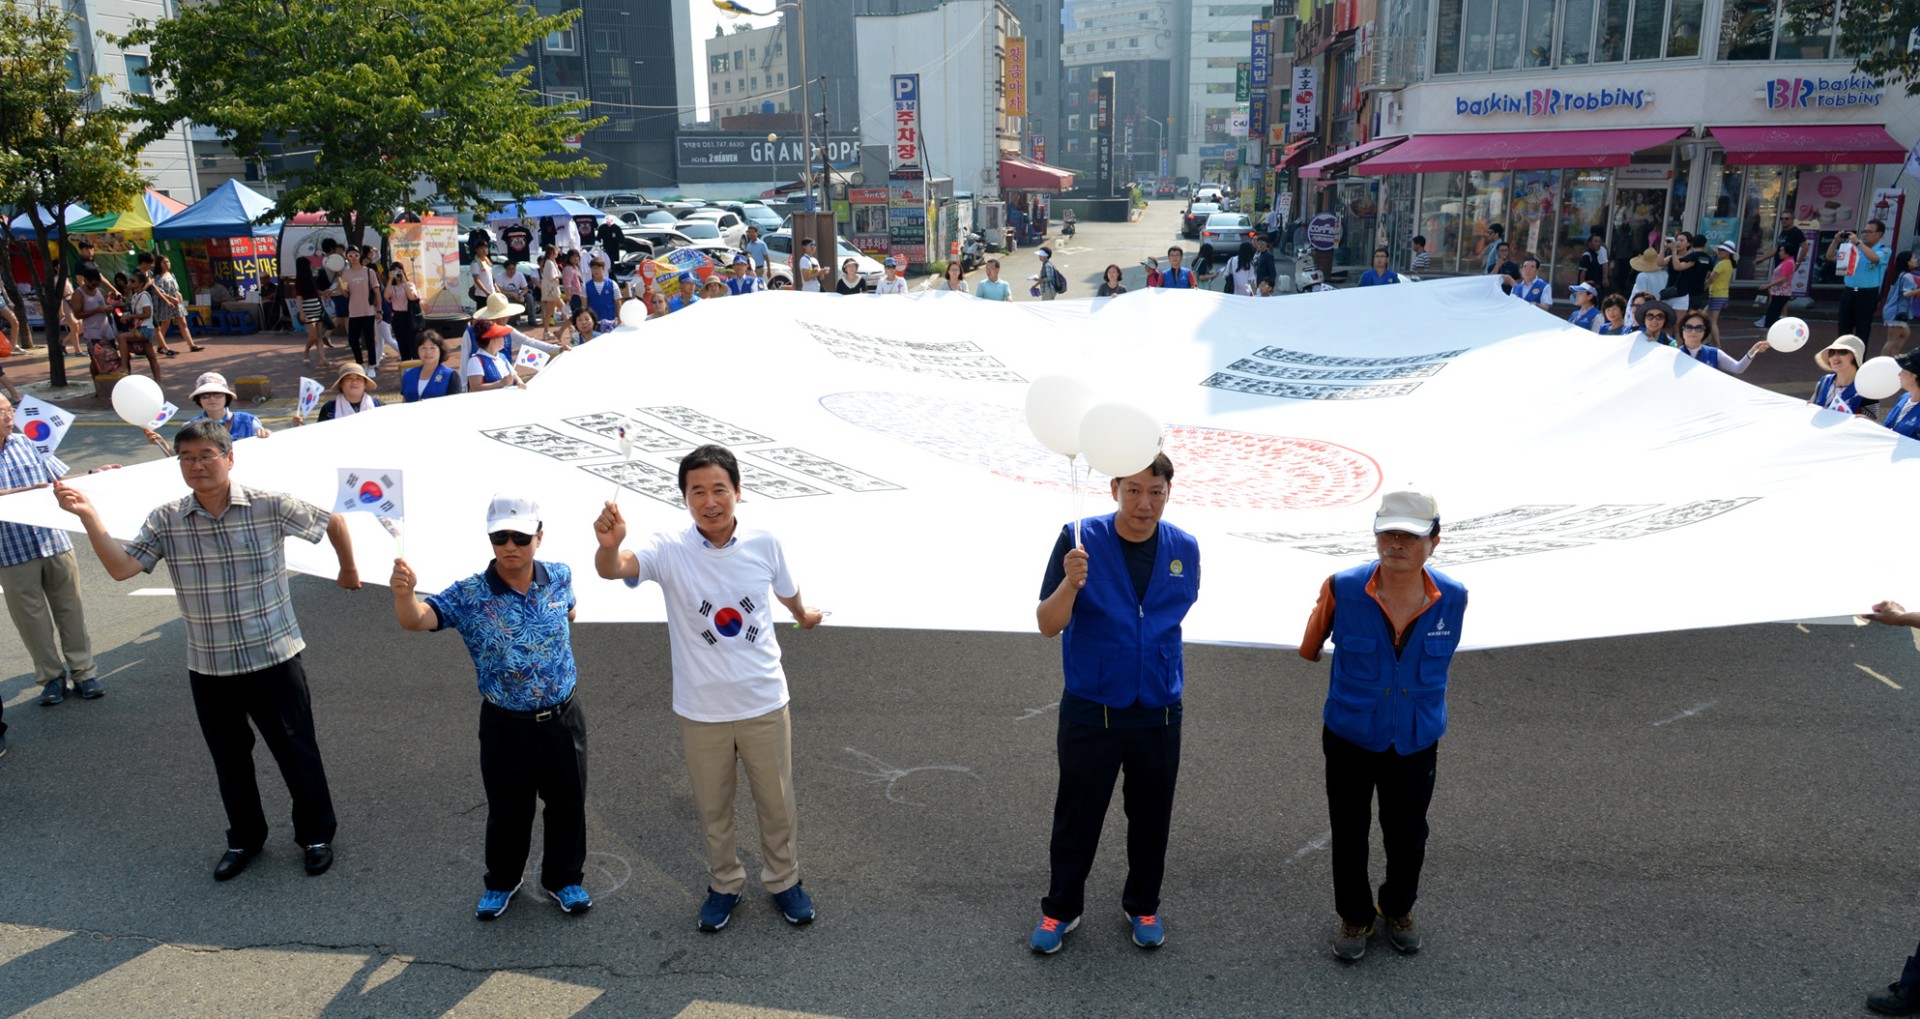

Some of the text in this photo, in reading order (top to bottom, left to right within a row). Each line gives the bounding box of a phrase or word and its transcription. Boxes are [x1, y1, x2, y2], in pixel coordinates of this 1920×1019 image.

[1254, 33, 1267, 81] 돼지국밥
[895, 78, 914, 99] P
[1008, 47, 1022, 111] 황금마차
[1818, 76, 1876, 91] baskin
[1456, 92, 1521, 116] baskin
[1564, 88, 1644, 111] robbins
[1818, 92, 1883, 107] robbins
[897, 111, 916, 160] 주차장
[828, 141, 860, 161] OPE
